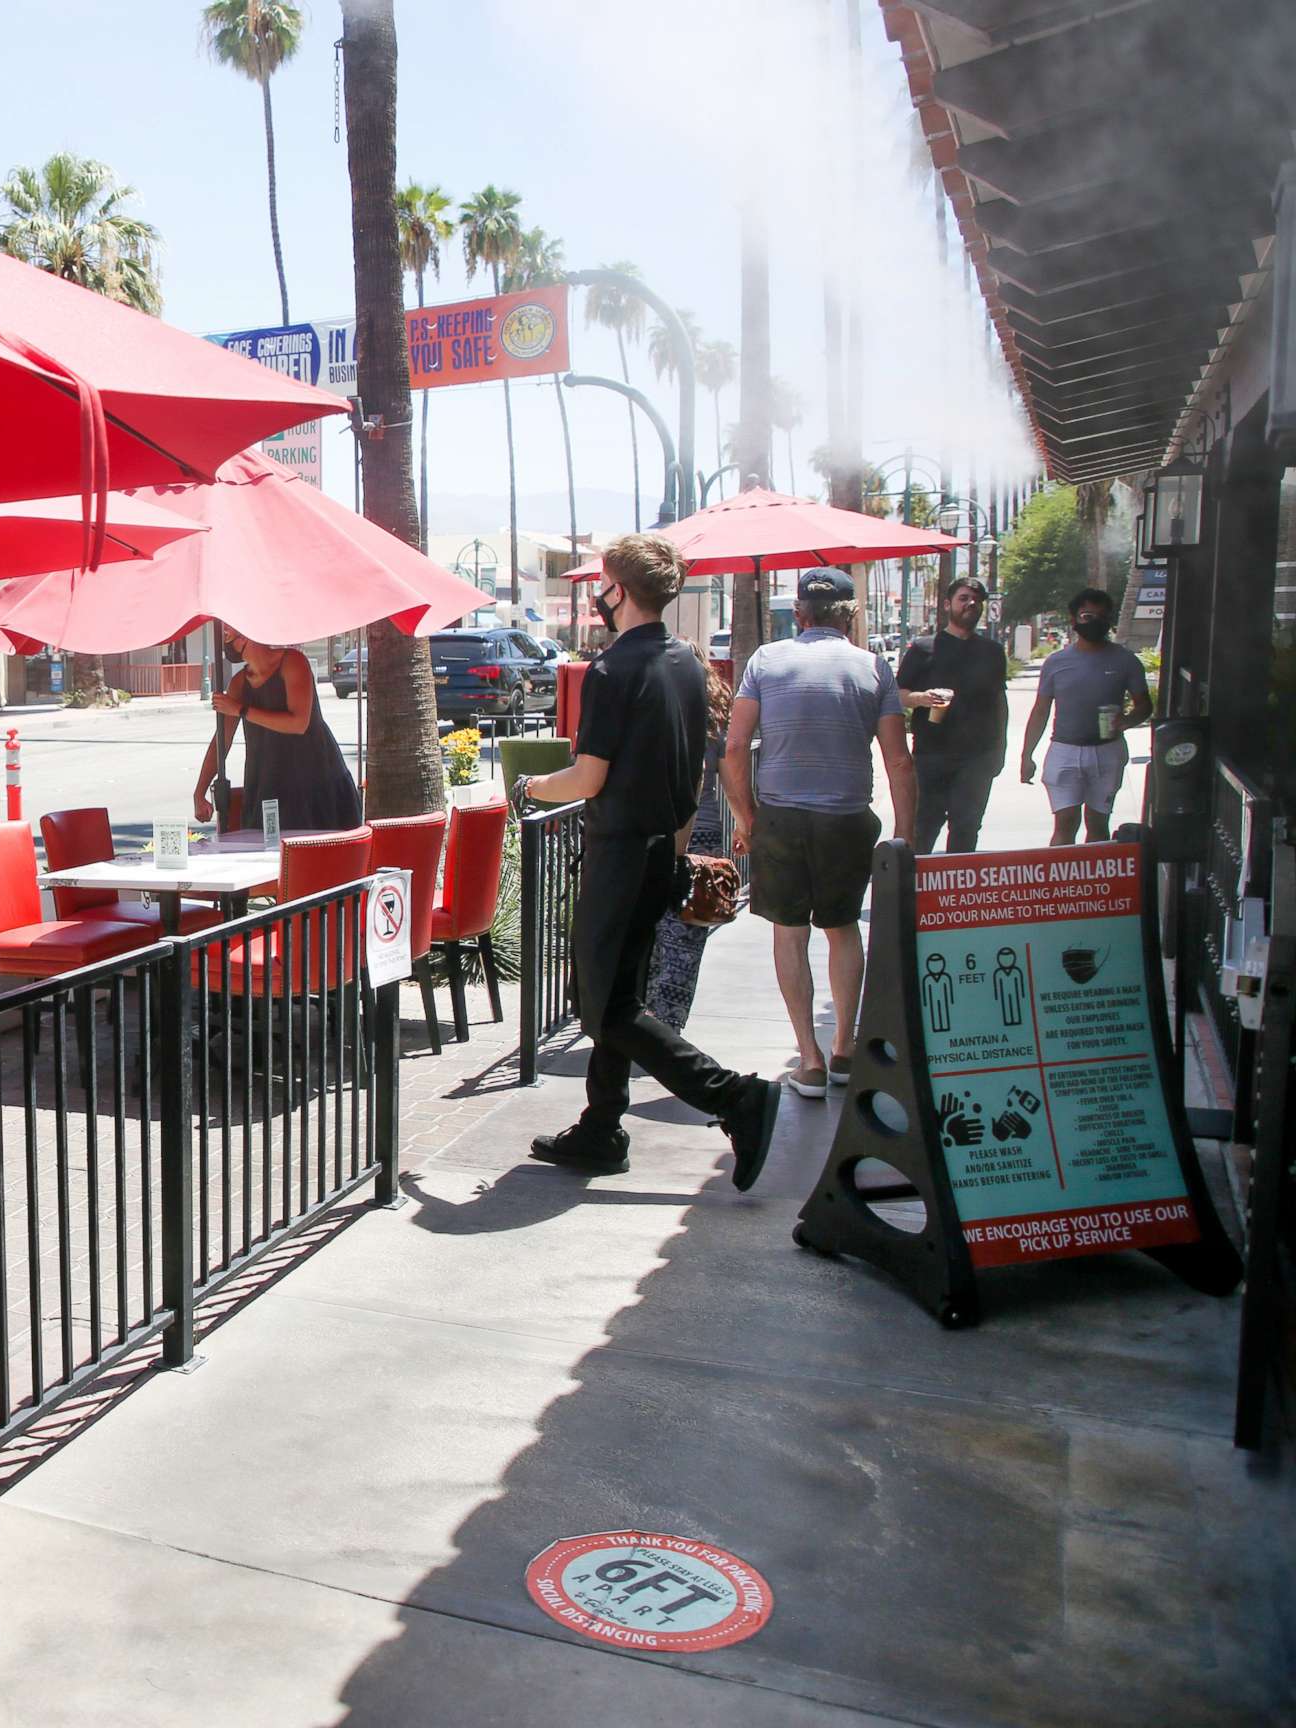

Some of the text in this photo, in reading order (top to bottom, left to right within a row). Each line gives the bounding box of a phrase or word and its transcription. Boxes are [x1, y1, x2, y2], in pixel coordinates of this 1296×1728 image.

[410, 317, 433, 343] P.S.
[437, 307, 493, 339] KEEPING
[257, 332, 313, 357] COVERINGS
[329, 328, 347, 364] IN
[410, 335, 494, 375] YOU SAFE
[267, 446, 317, 465] PARKING
[915, 857, 1135, 892] LIMITED SEATING AVAILABLE
[938, 883, 1111, 907] WE ADVISE CALLING AHEAD TO
[919, 897, 1132, 926] ADD YOUR NAME TO THE WAITING LIST
[966, 953, 976, 971] 6
[959, 973, 986, 984] FEET
[949, 1034, 1009, 1048] MAINTAIN A
[927, 1046, 1033, 1065] PHYSICAL DISTANCE
[965, 1158, 1032, 1174] AND/OR SANITIZE
[969, 1146, 1023, 1160] PLEASE WASH
[952, 1169, 1052, 1189] HANDS BEFORE ENTERING
[963, 1204, 1189, 1243] WE ENCOURAGE YOU TO USE OUR
[1019, 1227, 1132, 1253] PICK UP SERVICE
[606, 1536, 763, 1614] THANK YOU FOR PRACTICING
[637, 1548, 734, 1598] PLEASE STAY AT LEAST
[595, 1559, 723, 1615] 6FT
[536, 1578, 566, 1609] SOCIAL
[559, 1607, 657, 1646] DISTANCING
